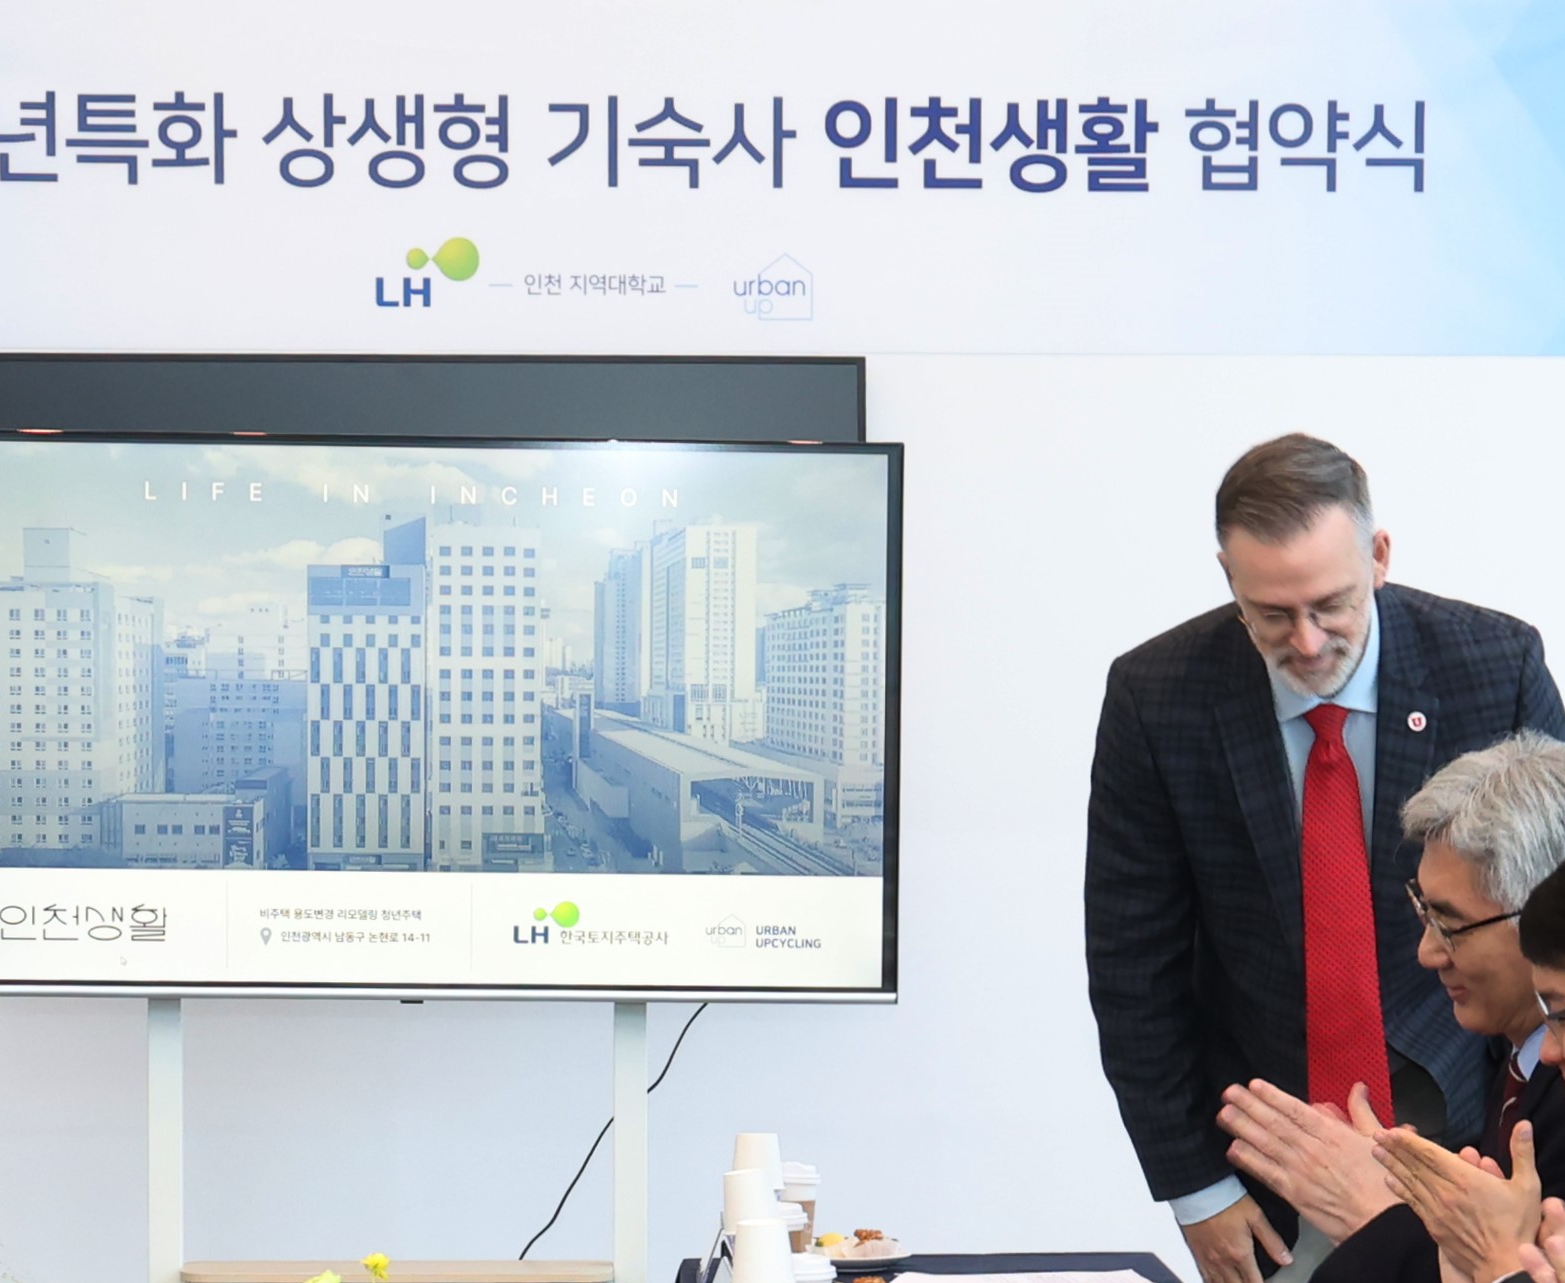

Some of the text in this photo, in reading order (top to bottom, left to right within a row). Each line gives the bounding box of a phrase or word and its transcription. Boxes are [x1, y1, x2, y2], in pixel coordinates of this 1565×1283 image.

[261, 92, 509, 190] 상생형
[547, 95, 797, 189] 기숙사
[824, 96, 1160, 194] 인천생활
[1184, 97, 1426, 193] 협약식
[375, 276, 432, 308] LH
[524, 273, 666, 296] 인천 지역대학교
[733, 276, 806, 297] urban
[143, 481, 682, 509] LIFE IN INCHEON
[259, 908, 422, 921] 비주택 용도변경 리모델링 청년주택
[280, 930, 332, 943] 인천광역시
[334, 931, 365, 944] 남동구
[402, 932, 431, 943] 14-11
[512, 925, 669, 946] LH 한국토지주택공사
[755, 925, 797, 936] URBAN
[755, 938, 822, 949] UPCYCLING
